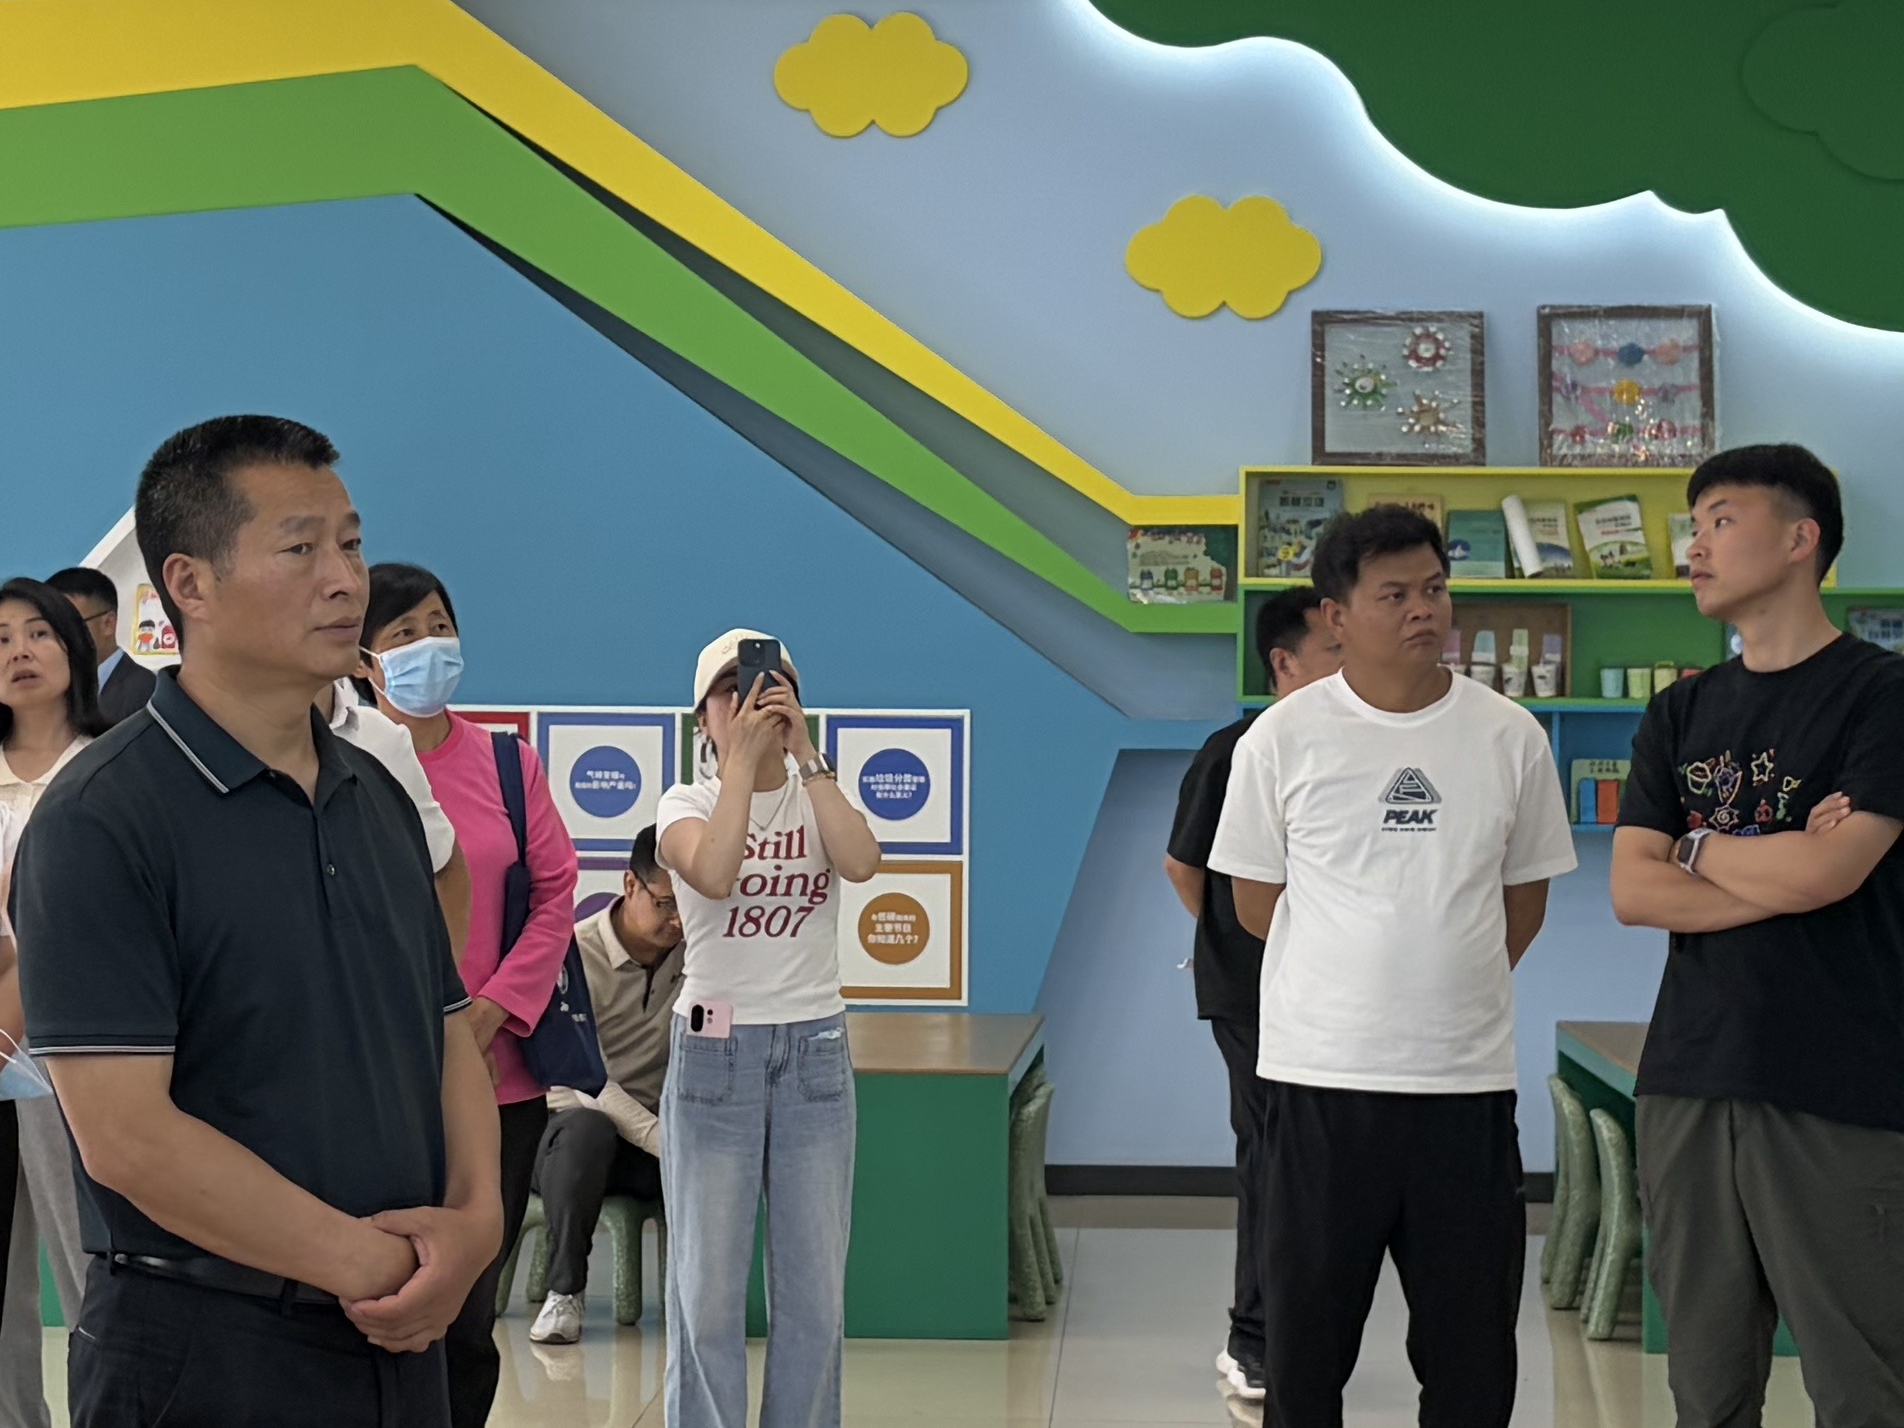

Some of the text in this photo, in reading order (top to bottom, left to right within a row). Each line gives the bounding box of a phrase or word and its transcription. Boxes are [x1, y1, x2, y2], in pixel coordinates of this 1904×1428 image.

[1383, 809, 1438, 824] PEAK
[743, 825, 807, 861] Still
[730, 865, 831, 906] oing
[722, 905, 815, 938] 1807
